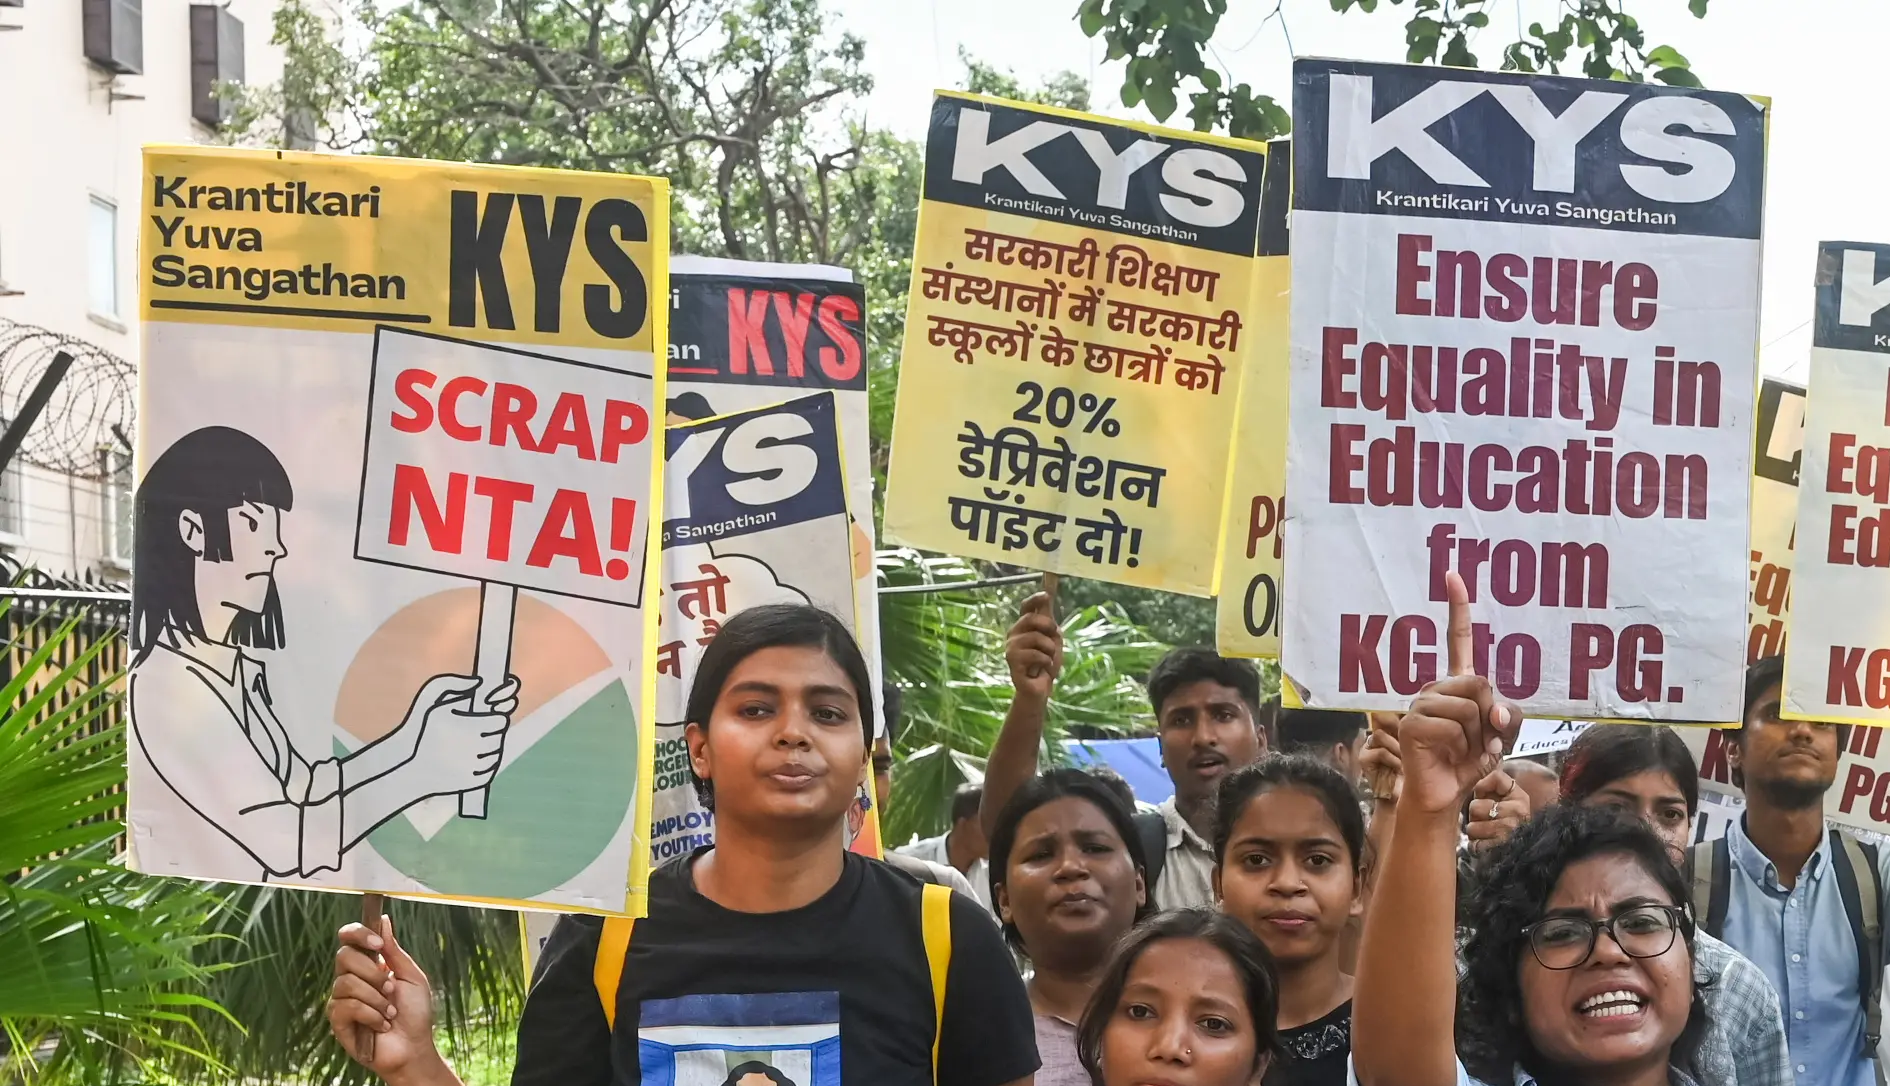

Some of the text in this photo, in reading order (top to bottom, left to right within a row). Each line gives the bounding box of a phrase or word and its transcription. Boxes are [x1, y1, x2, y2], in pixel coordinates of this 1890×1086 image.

[951, 107, 1248, 228] KYS
[1327, 74, 1736, 203] KYS
[151, 217, 263, 253] Yuva
[154, 176, 380, 219] Krantikari
[984, 192, 1198, 242] Krantikari Yuva Sangathan
[1375, 190, 1677, 226] Krantikari Yuva Sangathan
[152, 255, 407, 300] Sangathan
[447, 190, 649, 339] KYS
[922, 262, 1242, 353] संस्थानों में सरकारी
[964, 228, 1220, 302] सरकारी शिक्षण
[1395, 233, 1659, 330] Ensure
[726, 288, 862, 381] KYS
[927, 314, 1226, 395] स्कूलों के छात्रों को
[1320, 326, 1721, 430] Equality in
[390, 368, 650, 464] SCRAP
[1013, 381, 1121, 438] 20%
[664, 412, 819, 522] YS
[957, 421, 1166, 508] डेप्रिवेशन
[1328, 423, 1709, 520] Education
[387, 463, 638, 582] NTA!
[675, 510, 777, 541] Sangathan
[948, 487, 1143, 568] पॉइंट दो!
[1426, 523, 1610, 609] from
[1338, 613, 1437, 696] KG
[1471, 614, 1541, 700] to
[1568, 622, 1684, 703] PG.
